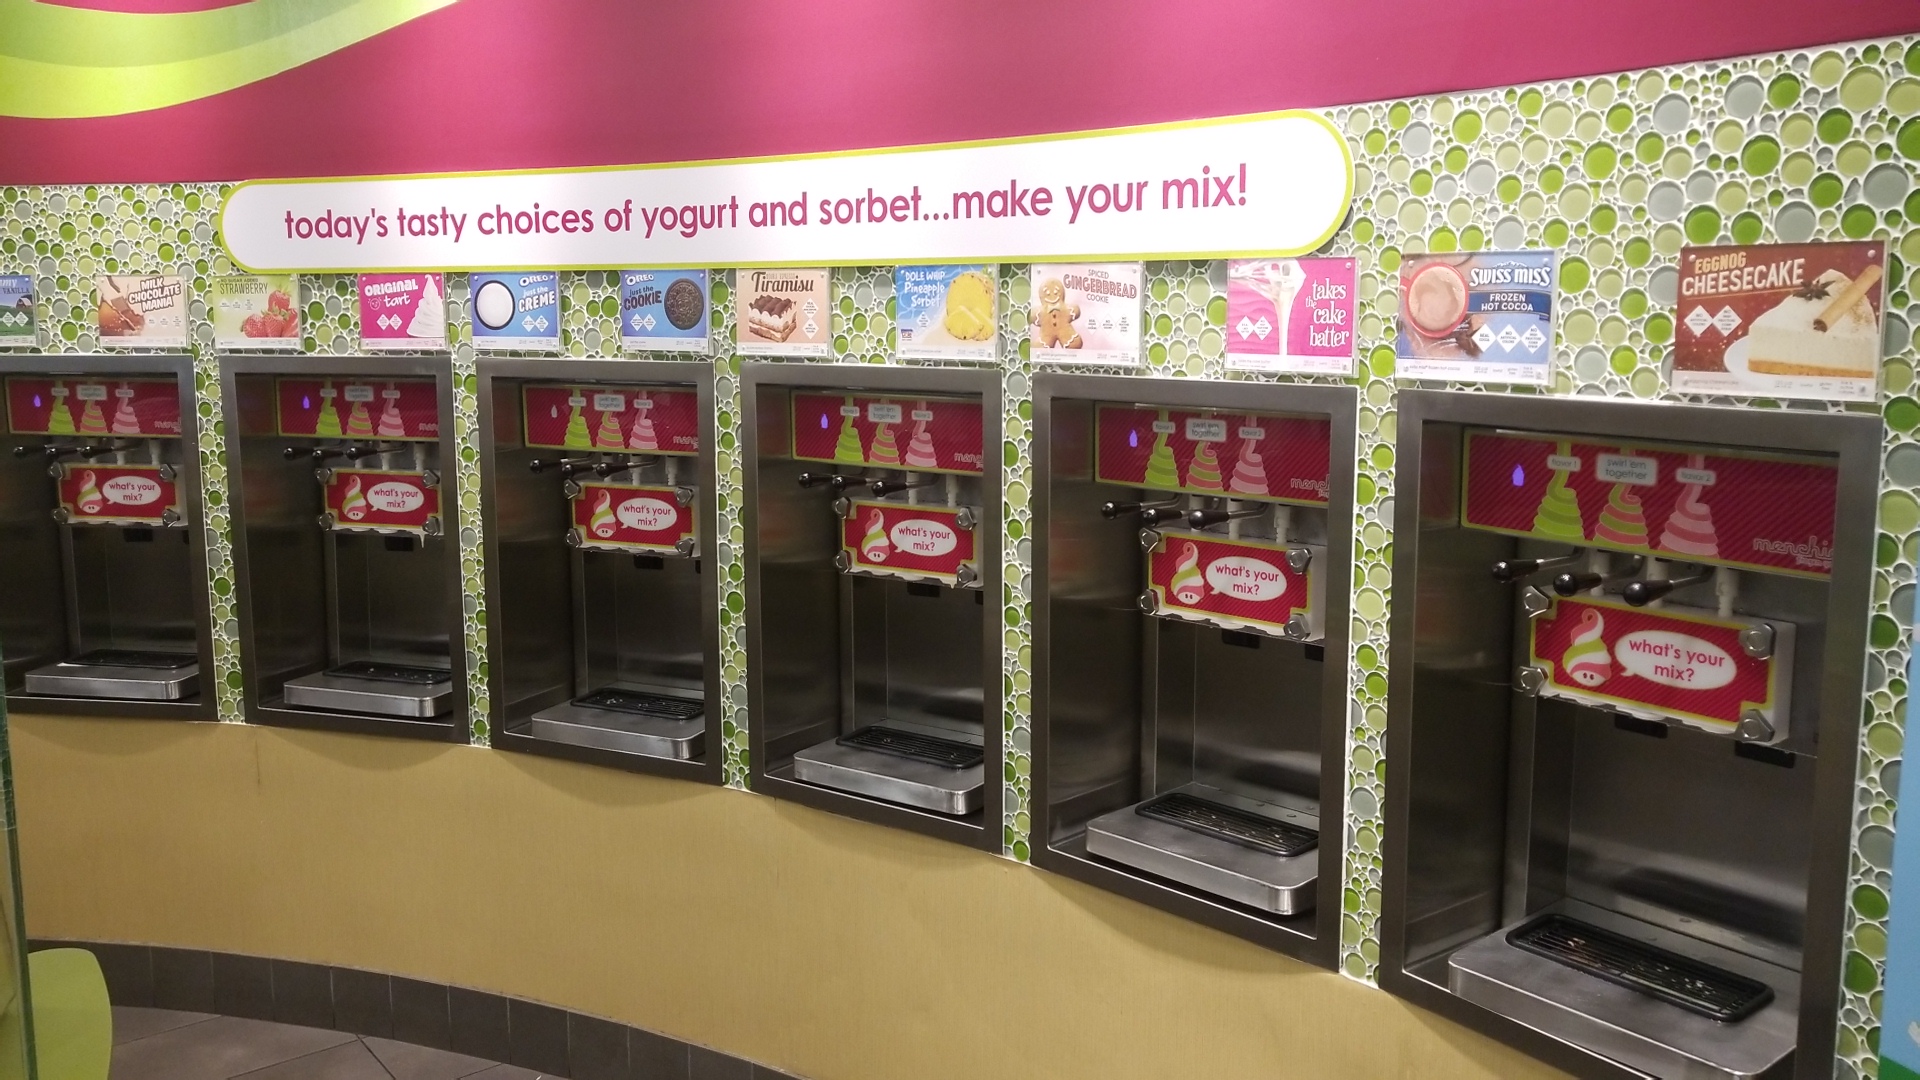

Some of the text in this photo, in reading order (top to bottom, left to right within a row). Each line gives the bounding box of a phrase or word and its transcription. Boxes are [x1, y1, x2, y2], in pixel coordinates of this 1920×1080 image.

[285, 208, 388, 245] today's
[397, 206, 467, 242] tasty
[477, 202, 594, 235] choices
[604, 199, 633, 233] of
[641, 195, 739, 239] yogurt
[749, 191, 808, 227] and
[1066, 181, 1149, 225] your
[1163, 163, 1247, 210] mix!
[1695, 251, 1747, 274] EGGNOG
[519, 275, 550, 288] OREO
[625, 274, 655, 286] OREO
[905, 270, 946, 281] DOLE WHIP
[1087, 269, 1110, 280] SPICED
[1469, 267, 1512, 287] SWISS
[1682, 258, 1806, 296] CHEESECAKE
[140, 276, 164, 292] MILK
[219, 282, 269, 294] STRAWBERRY
[751, 271, 814, 293] Tiramisu
[904, 281, 946, 297] Pineapple
[1063, 274, 1137, 299] GINGERBREAD
[1312, 278, 1347, 300] takes
[3, 287, 30, 295] VANILLA
[128, 284, 182, 304] CHOCOLATE
[522, 286, 549, 299] just the
[628, 285, 655, 298] just the
[1490, 293, 1526, 302] FROZEN
[141, 297, 175, 313] MANIA
[383, 292, 412, 308] tart
[518, 291, 555, 313] CREME
[623, 290, 662, 311] COOKIE
[911, 294, 941, 308] Sorbet
[1086, 293, 1110, 304] COOKIE
[1305, 296, 1317, 309] the
[1313, 301, 1347, 325] cake
[1481, 303, 1534, 312] HOT COCOA
[1309, 325, 1349, 347] batter
[1605, 469, 1648, 481] together
[109, 482, 155, 493] what's your
[373, 488, 418, 500] what's your
[123, 493, 143, 501] mix?
[386, 500, 406, 508] mix?
[623, 504, 671, 517] what's your
[637, 517, 658, 527] mix?
[898, 526, 951, 541] what's your
[912, 541, 935, 551] mix?
[1215, 564, 1280, 583] what's your
[1232, 582, 1260, 596] mix?
[1629, 638, 1726, 667] what's your
[1654, 664, 1695, 682] mix?
